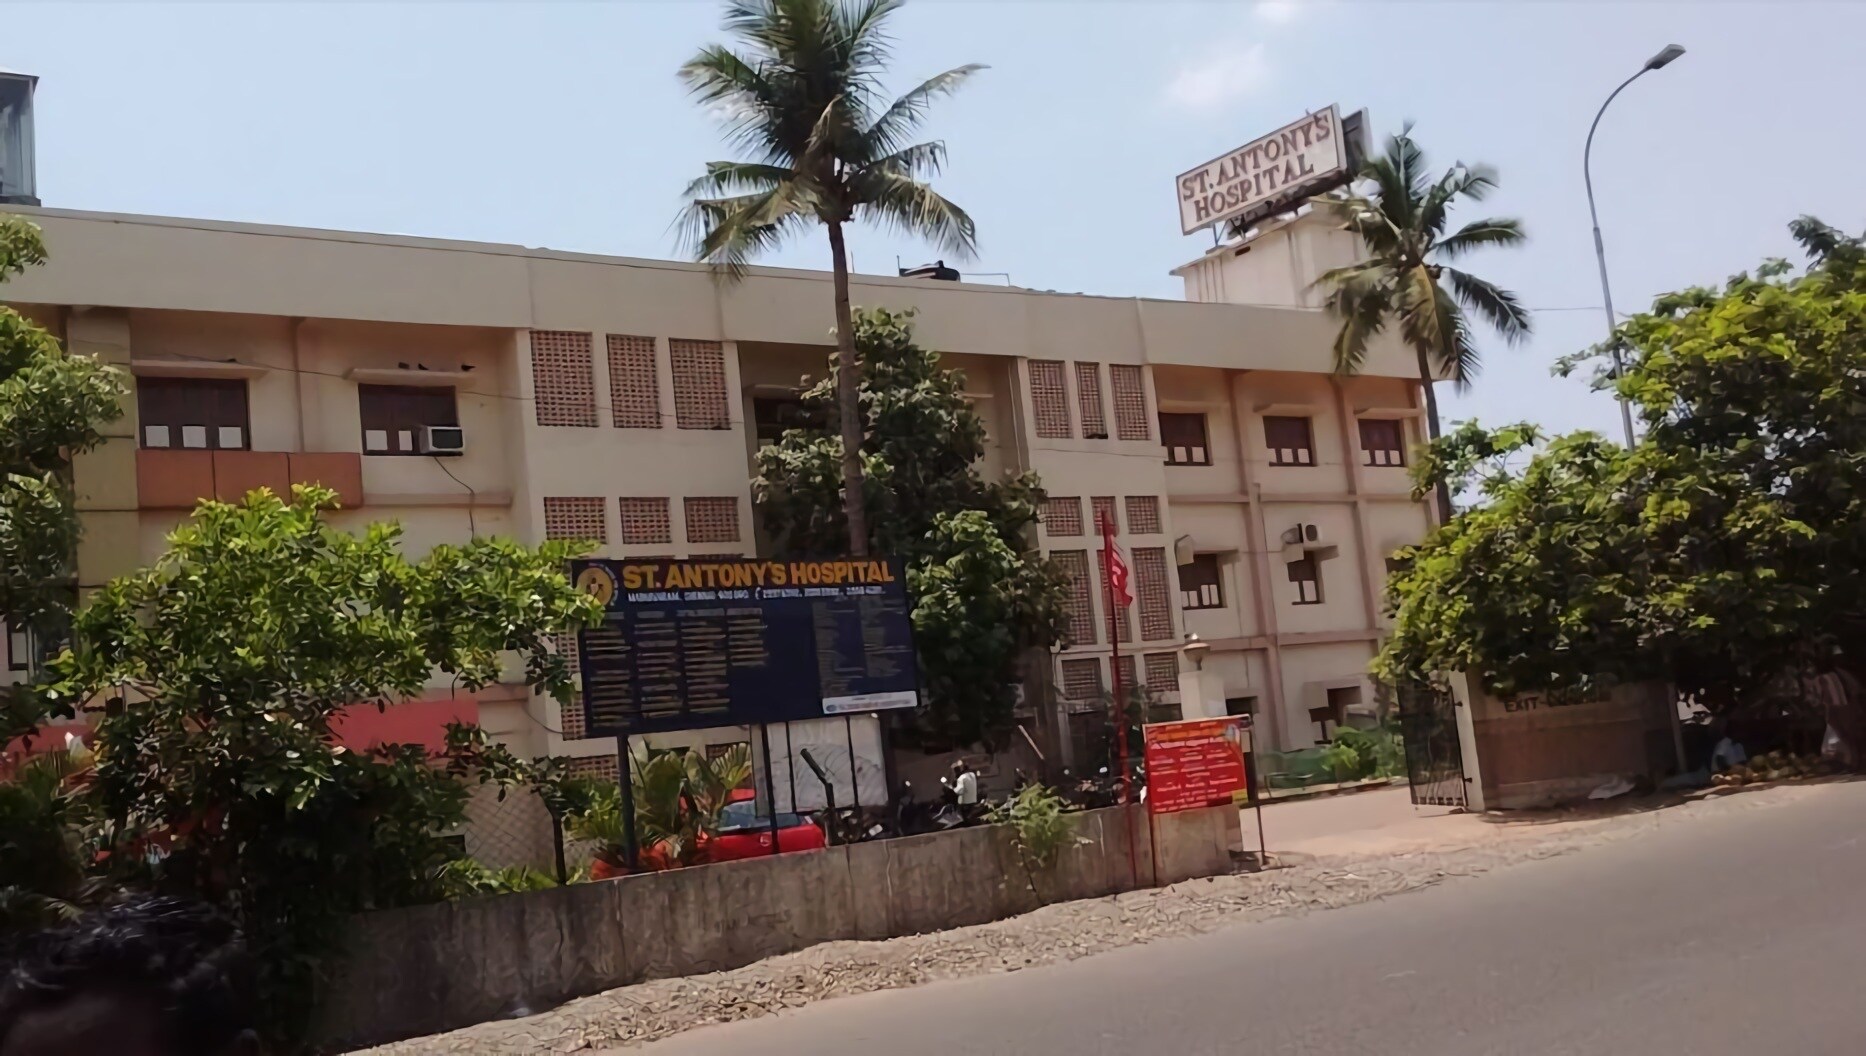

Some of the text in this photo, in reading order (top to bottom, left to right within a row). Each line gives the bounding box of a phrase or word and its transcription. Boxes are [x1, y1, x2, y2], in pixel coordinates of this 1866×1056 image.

[1193, 154, 1314, 222] HOSPITAL
[791, 560, 895, 585] HOSPITAL
[1503, 696, 1539, 713] EXIT
